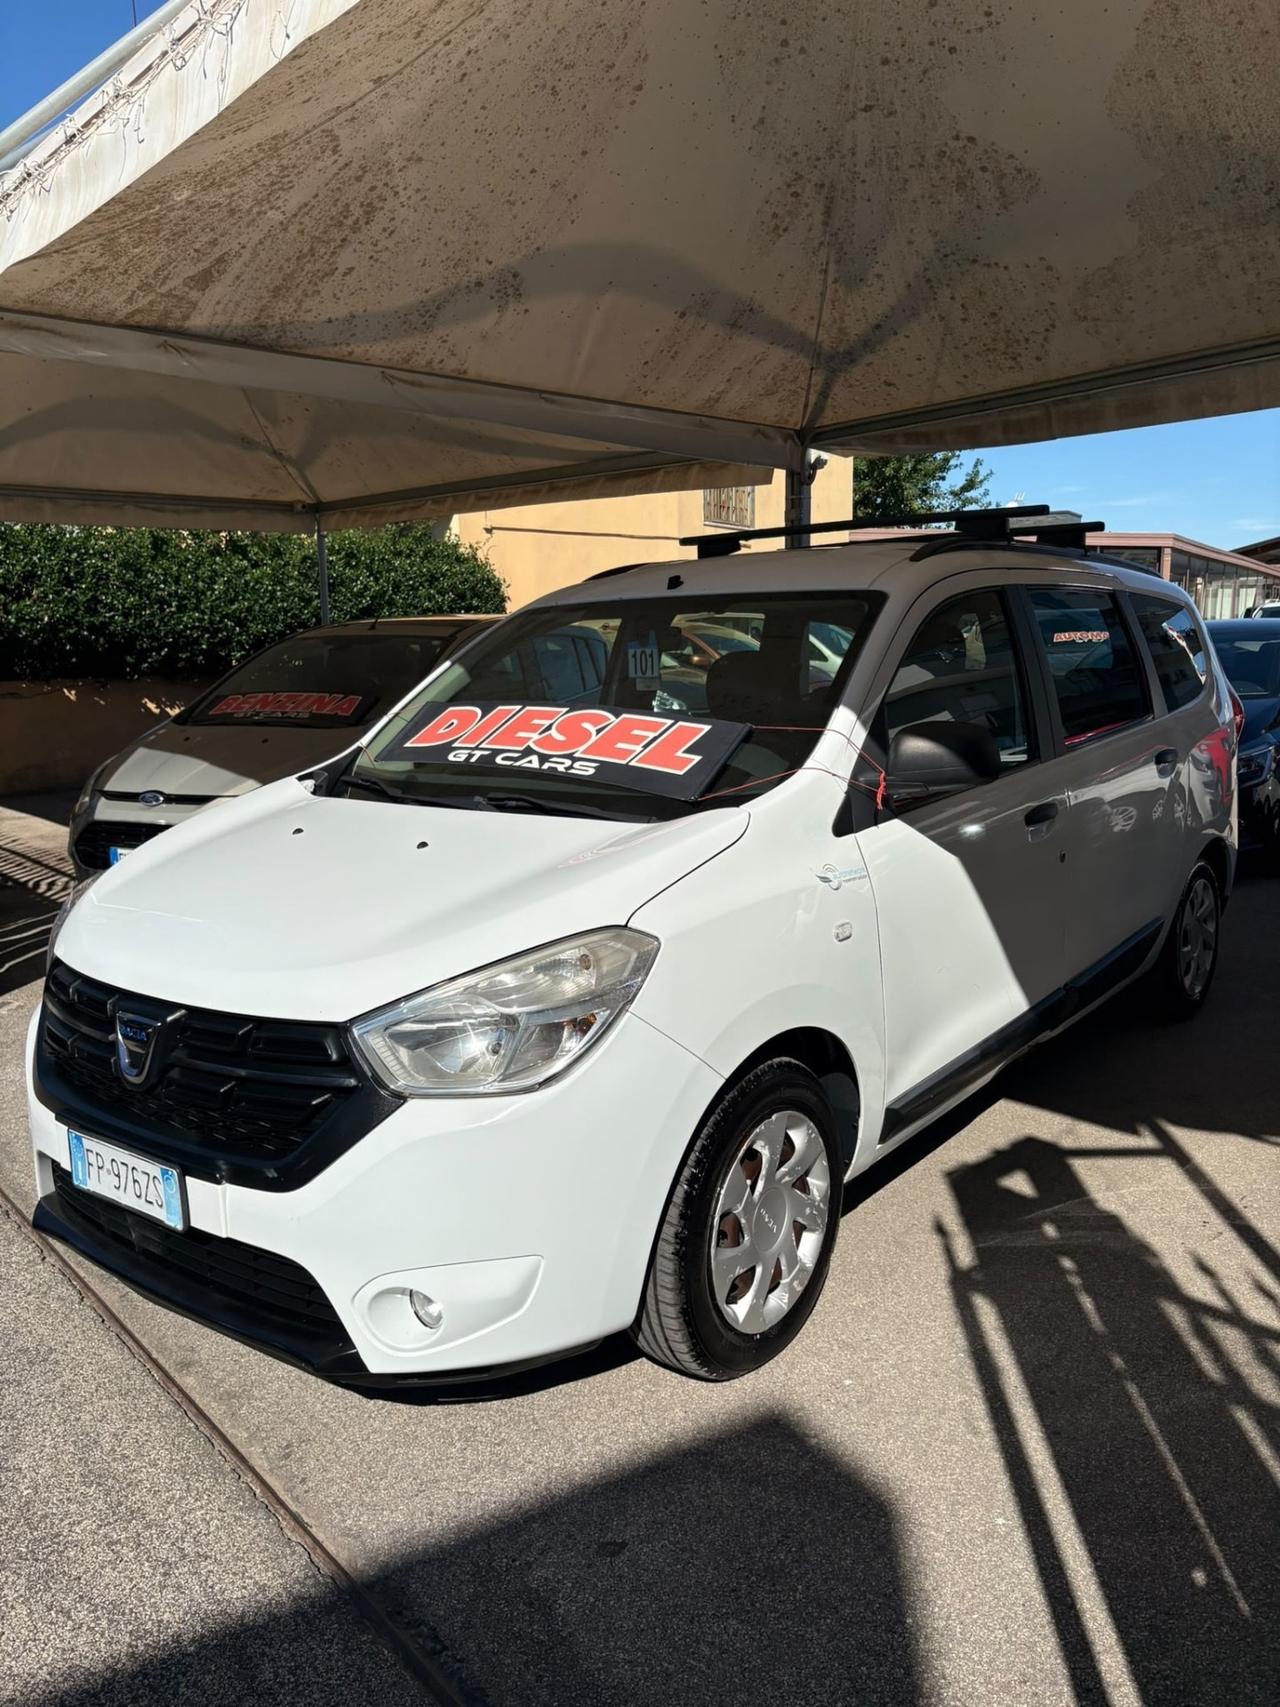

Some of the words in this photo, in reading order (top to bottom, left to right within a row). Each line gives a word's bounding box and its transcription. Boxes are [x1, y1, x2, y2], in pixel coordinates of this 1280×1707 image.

[631, 650, 655, 676] 101
[208, 692, 362, 716] BENZINA
[403, 705, 712, 776] DIESEL
[447, 749, 491, 763] GT
[495, 752, 600, 776] CARS
